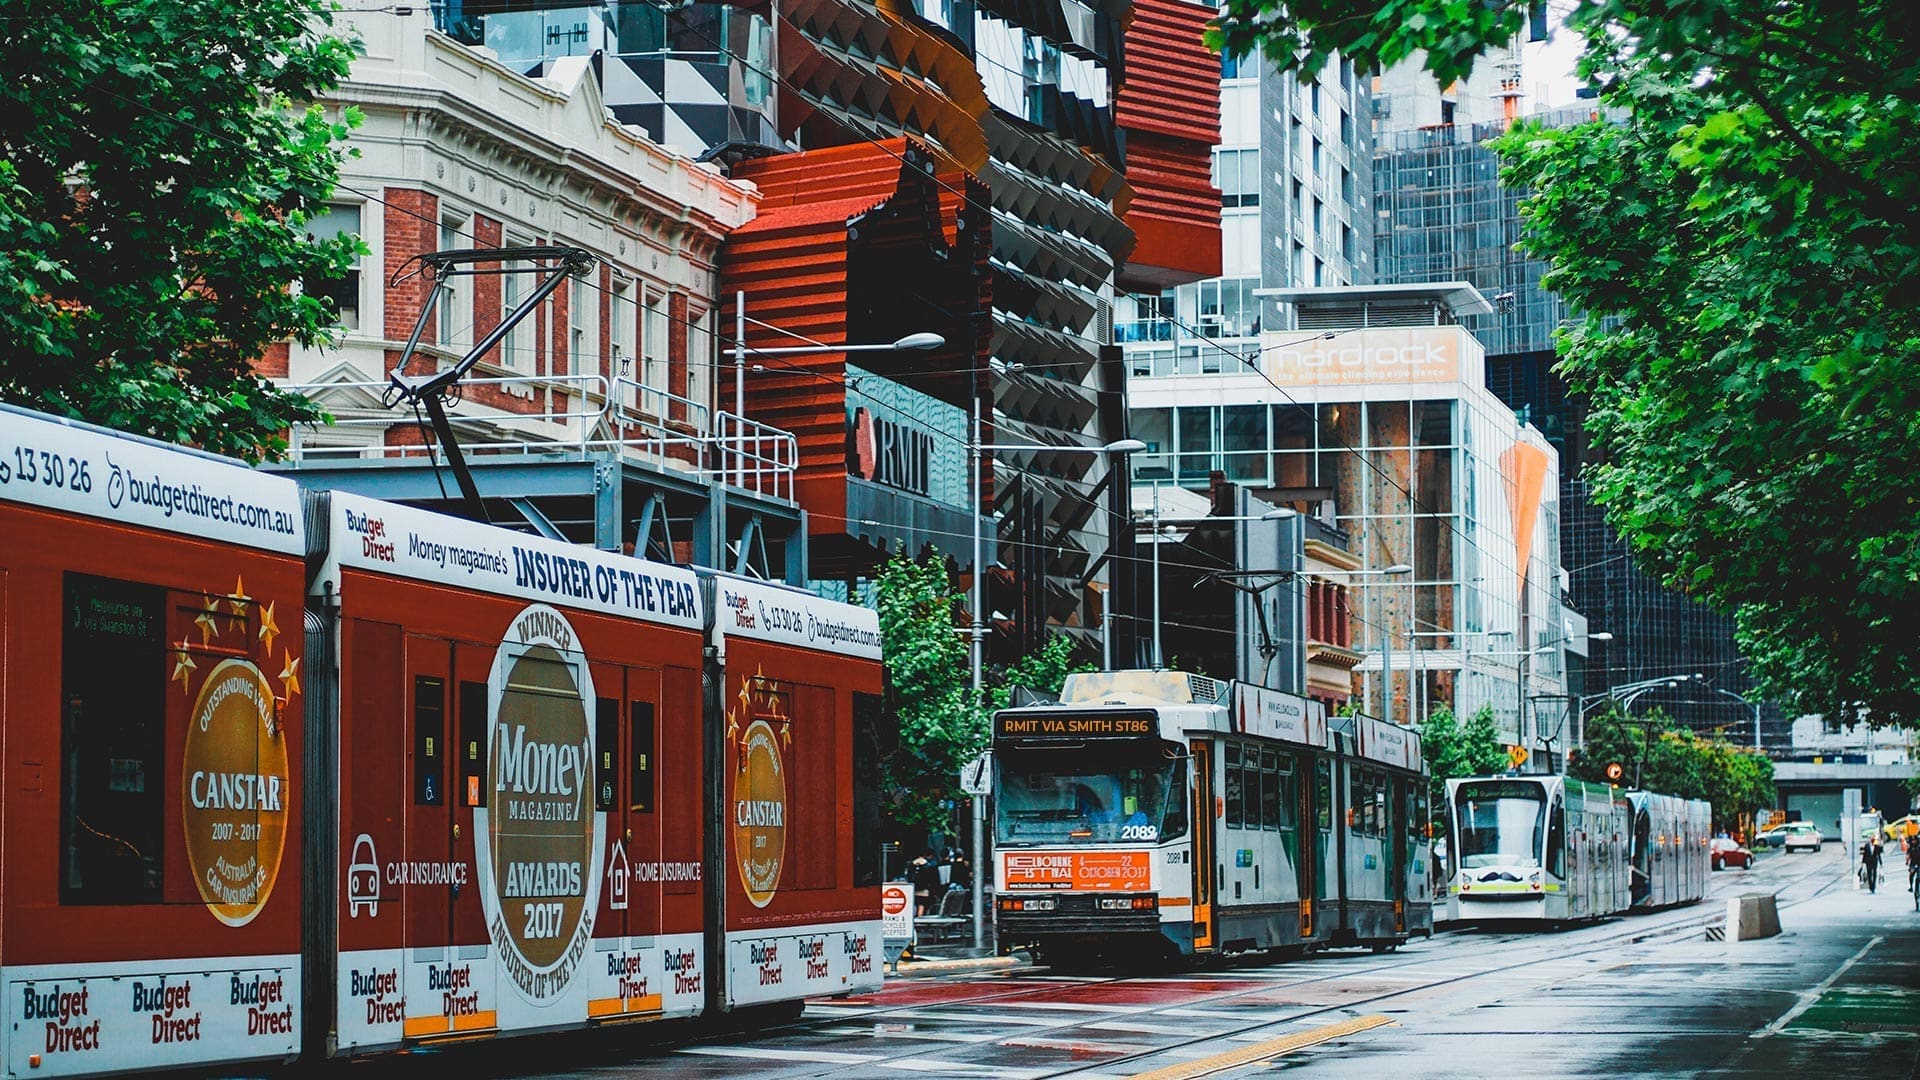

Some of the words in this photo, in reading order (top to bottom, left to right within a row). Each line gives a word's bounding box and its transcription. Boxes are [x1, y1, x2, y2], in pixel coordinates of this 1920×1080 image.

[878, 417, 934, 497] RMIT
[15, 446, 37, 482] 13
[40, 451, 64, 488] 30
[69, 457, 92, 493] 26
[127, 470, 295, 535] budgetdirect.com.au
[346, 508, 386, 541] Budget
[362, 535, 395, 563] Direct
[409, 532, 447, 569] Money
[448, 544, 508, 575] magazine's
[512, 546, 593, 600] INSURER
[596, 564, 618, 605] OF
[620, 570, 655, 612] THE
[655, 577, 697, 619] YEAR
[724, 589, 749, 613] Budget
[735, 610, 756, 630] Direct
[771, 607, 781, 628] 13
[781, 608, 792, 631] 30
[792, 611, 803, 634] 26
[517, 612, 572, 658] WINNER
[200, 677, 254, 732] OUTSTANDING
[1005, 720, 1038, 732] RMIT
[1042, 720, 1065, 732] VIA
[1068, 720, 1111, 732] SMITH
[1115, 720, 1149, 732] ST86
[496, 723, 589, 821] Money
[191, 771, 281, 812] CANSTAR
[509, 800, 572, 821] MAGAZINE
[737, 800, 783, 827] CANSTAR
[212, 823, 233, 841] 2007
[240, 824, 261, 841] 2017
[755, 835, 767, 848] 2017
[1121, 825, 1158, 840] 2089
[216, 856, 257, 882] AUSTRALIA
[635, 863, 657, 881] HOME
[659, 862, 701, 881] INSURANCE
[1007, 857, 1072, 867] MELBOURNE
[1167, 852, 1181, 864] 2089
[207, 866, 223, 898] CAR
[386, 862, 409, 884] CAR
[411, 863, 467, 885] INSURANCE
[505, 862, 581, 897] AWARDS
[1122, 866, 1147, 878] 2017
[524, 903, 564, 939] 2017
[491, 912, 533, 994] INSURER
[535, 972, 547, 999] OF
[549, 961, 569, 996] THE
[569, 909, 593, 972] YEAR
[751, 941, 777, 967] Budget
[799, 939, 824, 962] Budget
[844, 934, 866, 957] Budget
[607, 951, 641, 978] Budget
[664, 948, 695, 975] Budget
[759, 963, 782, 986] Direct
[807, 959, 828, 979] Direct
[851, 954, 872, 974] Direct
[351, 967, 397, 1001] Budget
[428, 963, 470, 994] Budget
[619, 976, 647, 1000] Direct
[675, 972, 701, 995] Direct
[24, 985, 88, 1026] Budget
[132, 979, 191, 1018] Budget
[230, 975, 283, 1011] Budget
[443, 991, 478, 1017] Direct
[248, 1005, 292, 1036] Direct
[367, 996, 406, 1025] Direct
[46, 1019, 99, 1054] Direct
[152, 1012, 200, 1044] Direct
